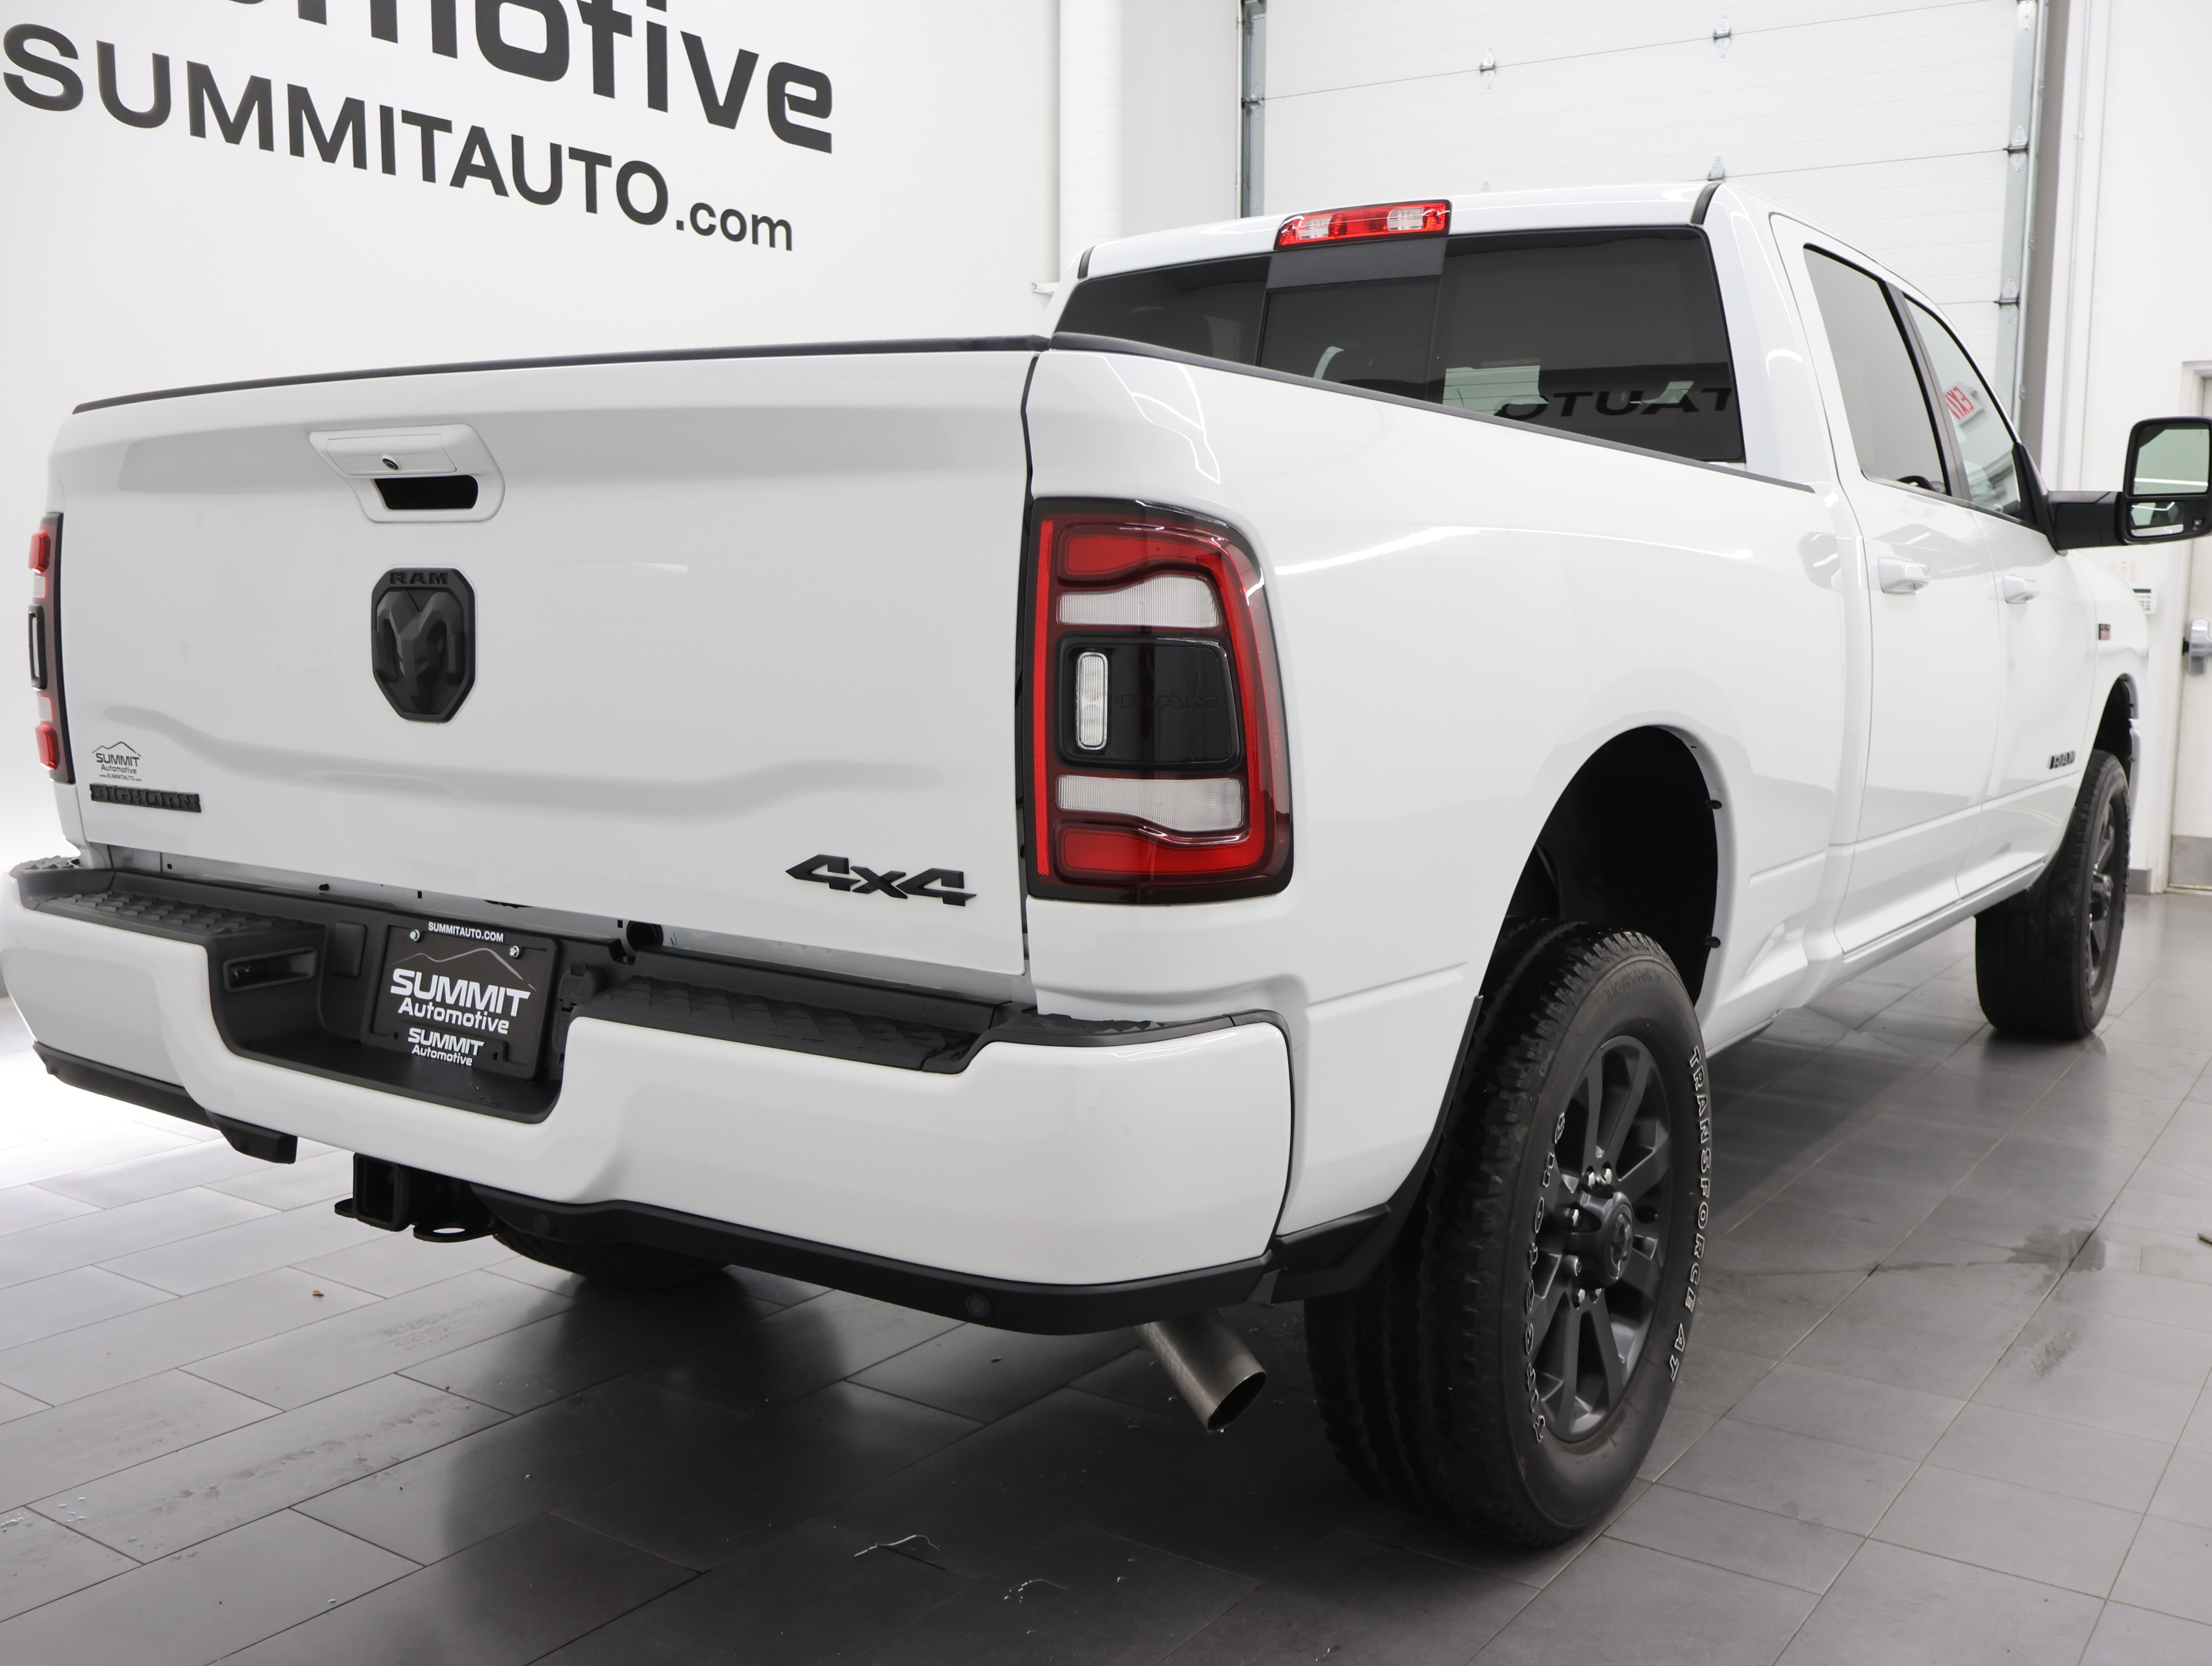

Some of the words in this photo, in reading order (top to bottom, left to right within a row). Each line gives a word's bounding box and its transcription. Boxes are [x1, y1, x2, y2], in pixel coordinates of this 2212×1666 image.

[3, 23, 793, 251] SUMMITAUTO.com
[390, 572, 448, 584] RAM
[1121, 695, 1218, 709] RAM
[96, 753, 139, 767] SUMMIT
[101, 764, 137, 774] Automotive
[428, 922, 503, 942] SUMMITAUTO.COM
[390, 968, 531, 1017] SUMMIT
[398, 997, 509, 1034] Automotive
[408, 1027, 484, 1056] SUMMIT
[412, 1044, 472, 1066] Automotive
[1685, 1045, 1711, 1313] TRANSFORCE
[1669, 1322, 1685, 1382] AT
